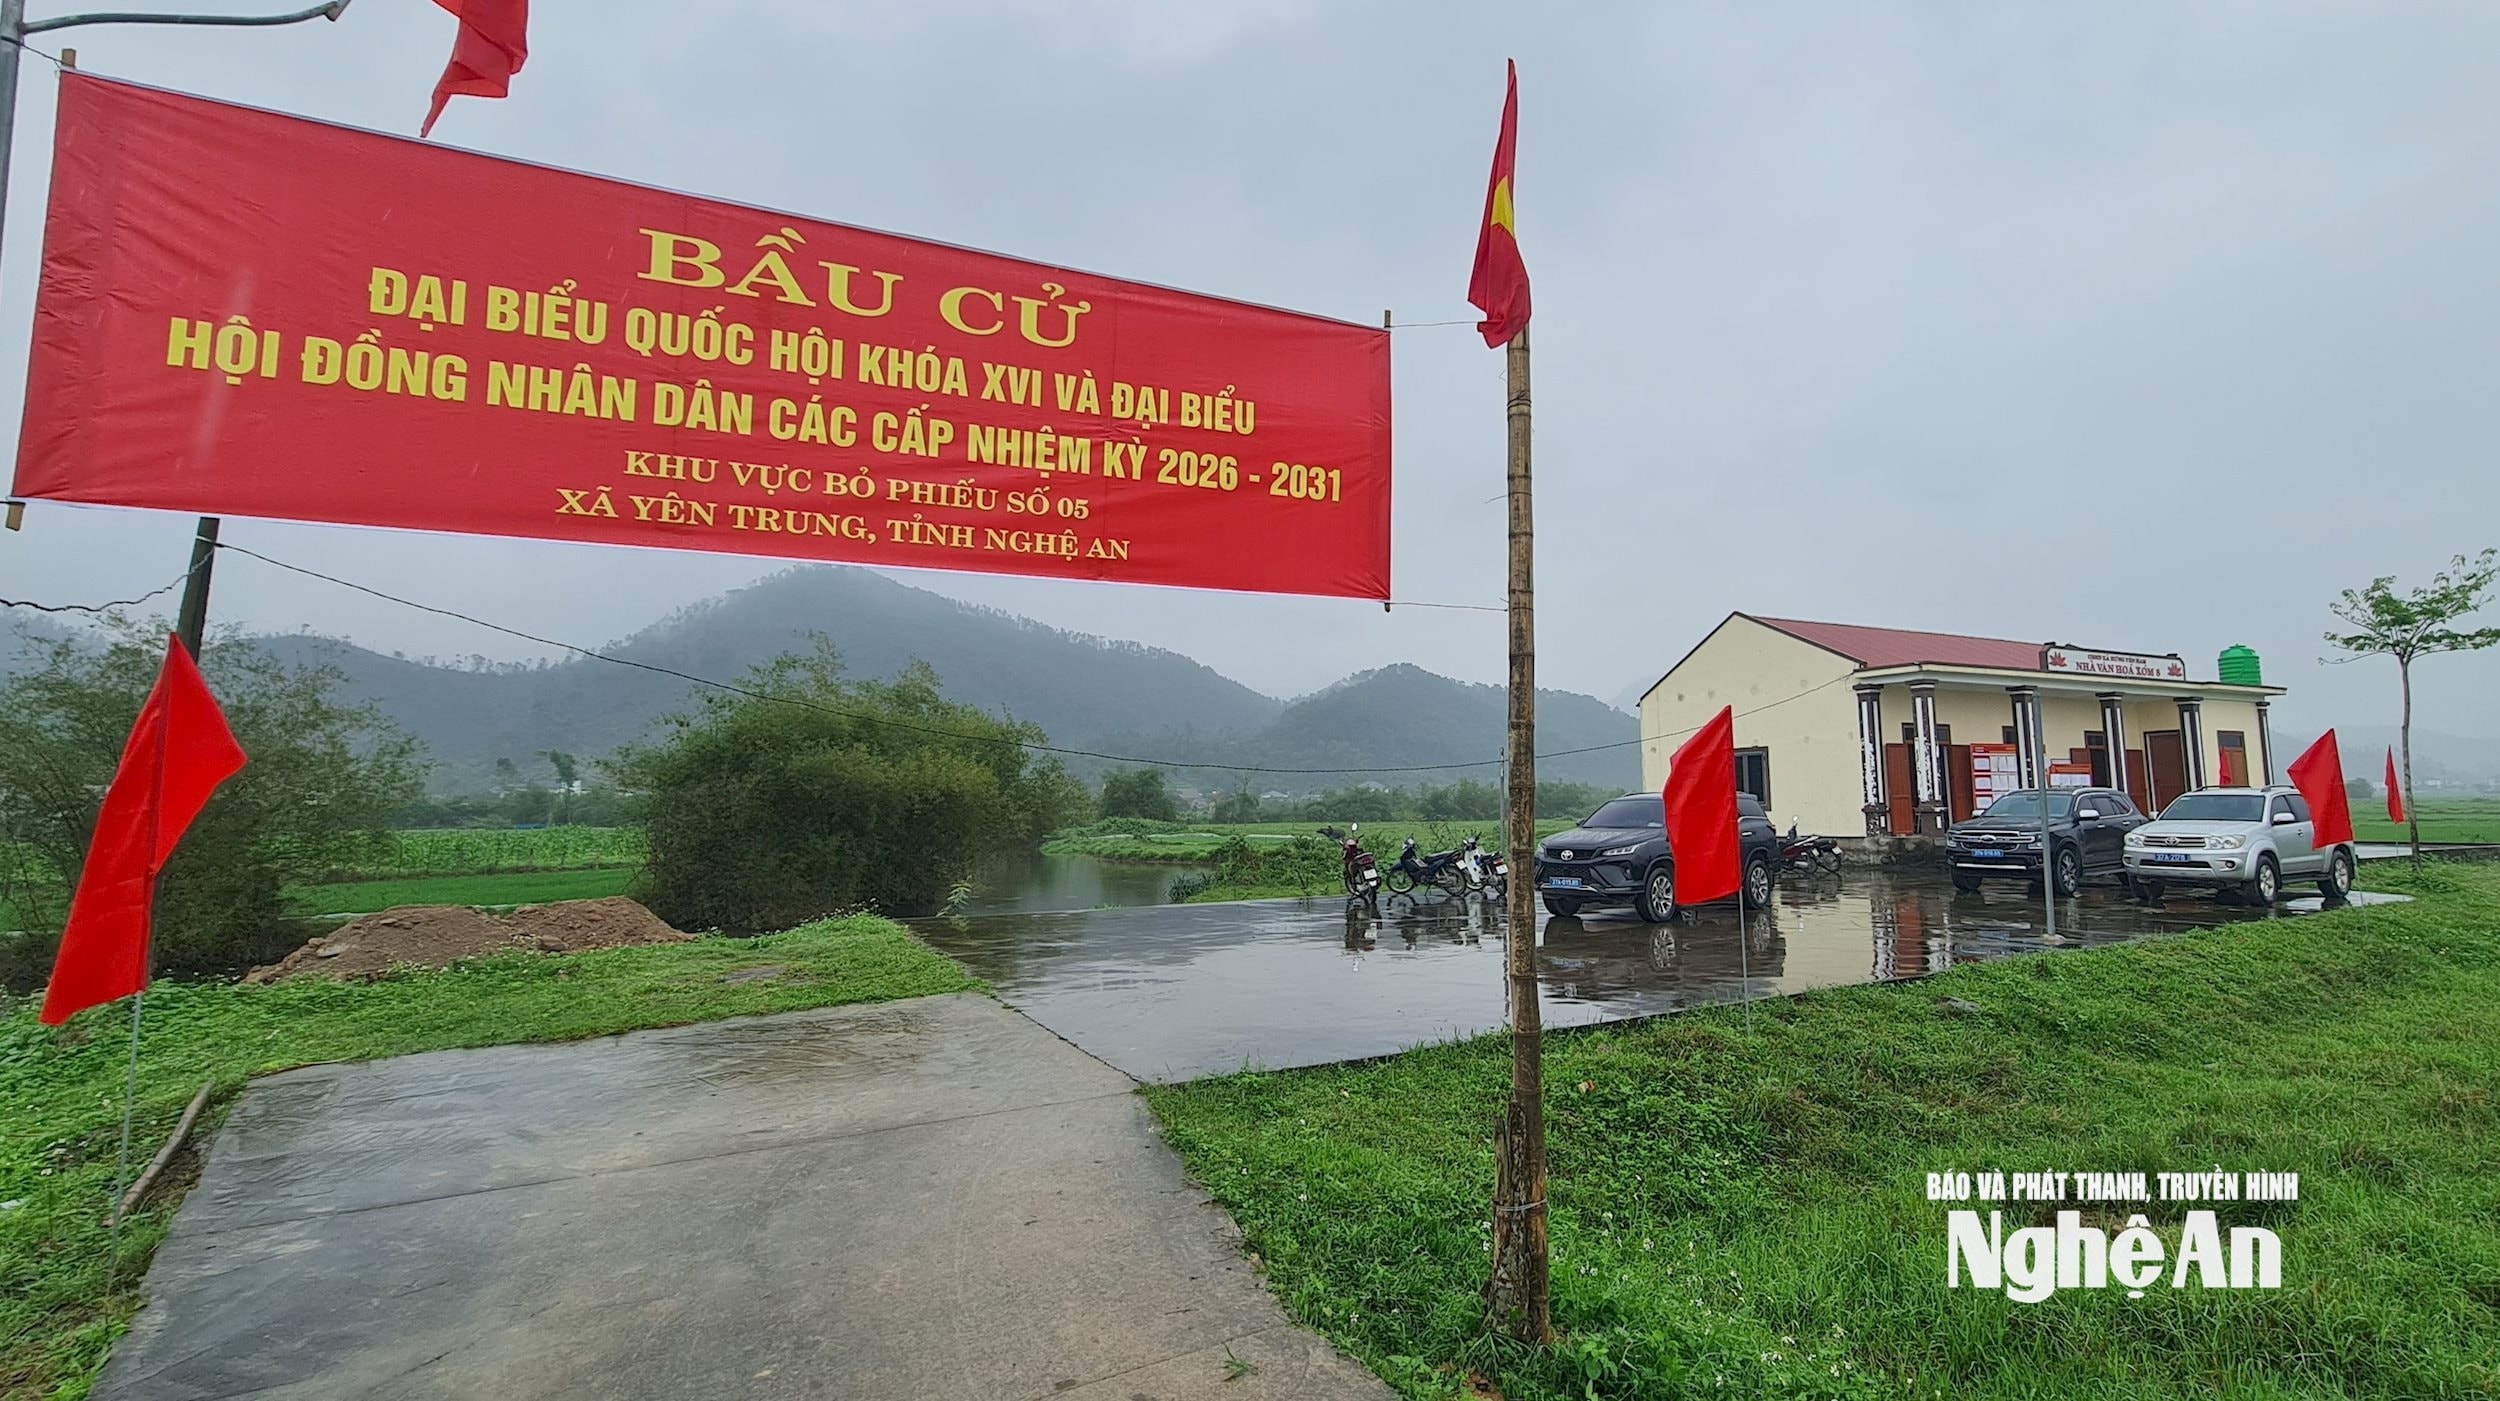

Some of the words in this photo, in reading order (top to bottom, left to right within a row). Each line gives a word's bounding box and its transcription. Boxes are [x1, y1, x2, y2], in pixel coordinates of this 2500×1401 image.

[636, 227, 904, 317] BẦU
[939, 282, 1092, 349] CỬ
[368, 268, 467, 333] ĐẠI
[486, 279, 608, 345] BIỂU
[625, 308, 754, 368] QUỐC
[769, 326, 844, 386] HỘI
[858, 344, 969, 397] KHÓA
[981, 362, 1042, 408] XVI
[1055, 370, 1101, 415] VÀ
[1110, 382, 1169, 425] ĐẠI
[1180, 385, 1256, 436] BIỂU
[166, 316, 281, 386] HỘI
[300, 328, 468, 402] ĐỒNG
[486, 361, 636, 422] NHÂN
[653, 382, 754, 436] DÂN
[768, 398, 858, 449] CÁC
[872, 403, 955, 458] CẤP
[967, 423, 1091, 479] NHIỆM
[1103, 437, 1149, 481] KỲ
[1157, 448, 1238, 491] 2026
[1248, 474, 1261, 483] -
[1268, 462, 1342, 502] 2031
[555, 485, 619, 519] XÃ
[629, 491, 718, 527] YÊN
[728, 504, 877, 545] TRUNG,
[886, 513, 976, 549] TỈNH
[983, 528, 1079, 562] NGHỆ
[1085, 537, 1131, 561] AN
[624, 450, 720, 483] KHU
[728, 461, 812, 496] VỰC
[822, 466, 877, 499] BỎ
[886, 478, 999, 511] PHIẾU
[1006, 486, 1050, 516] SỐ
[1057, 497, 1090, 520] 05
[2075, 660, 2096, 673] NHÀ
[2116, 664, 2134, 676] HOÁ
[2135, 665, 2155, 677] XÓM
